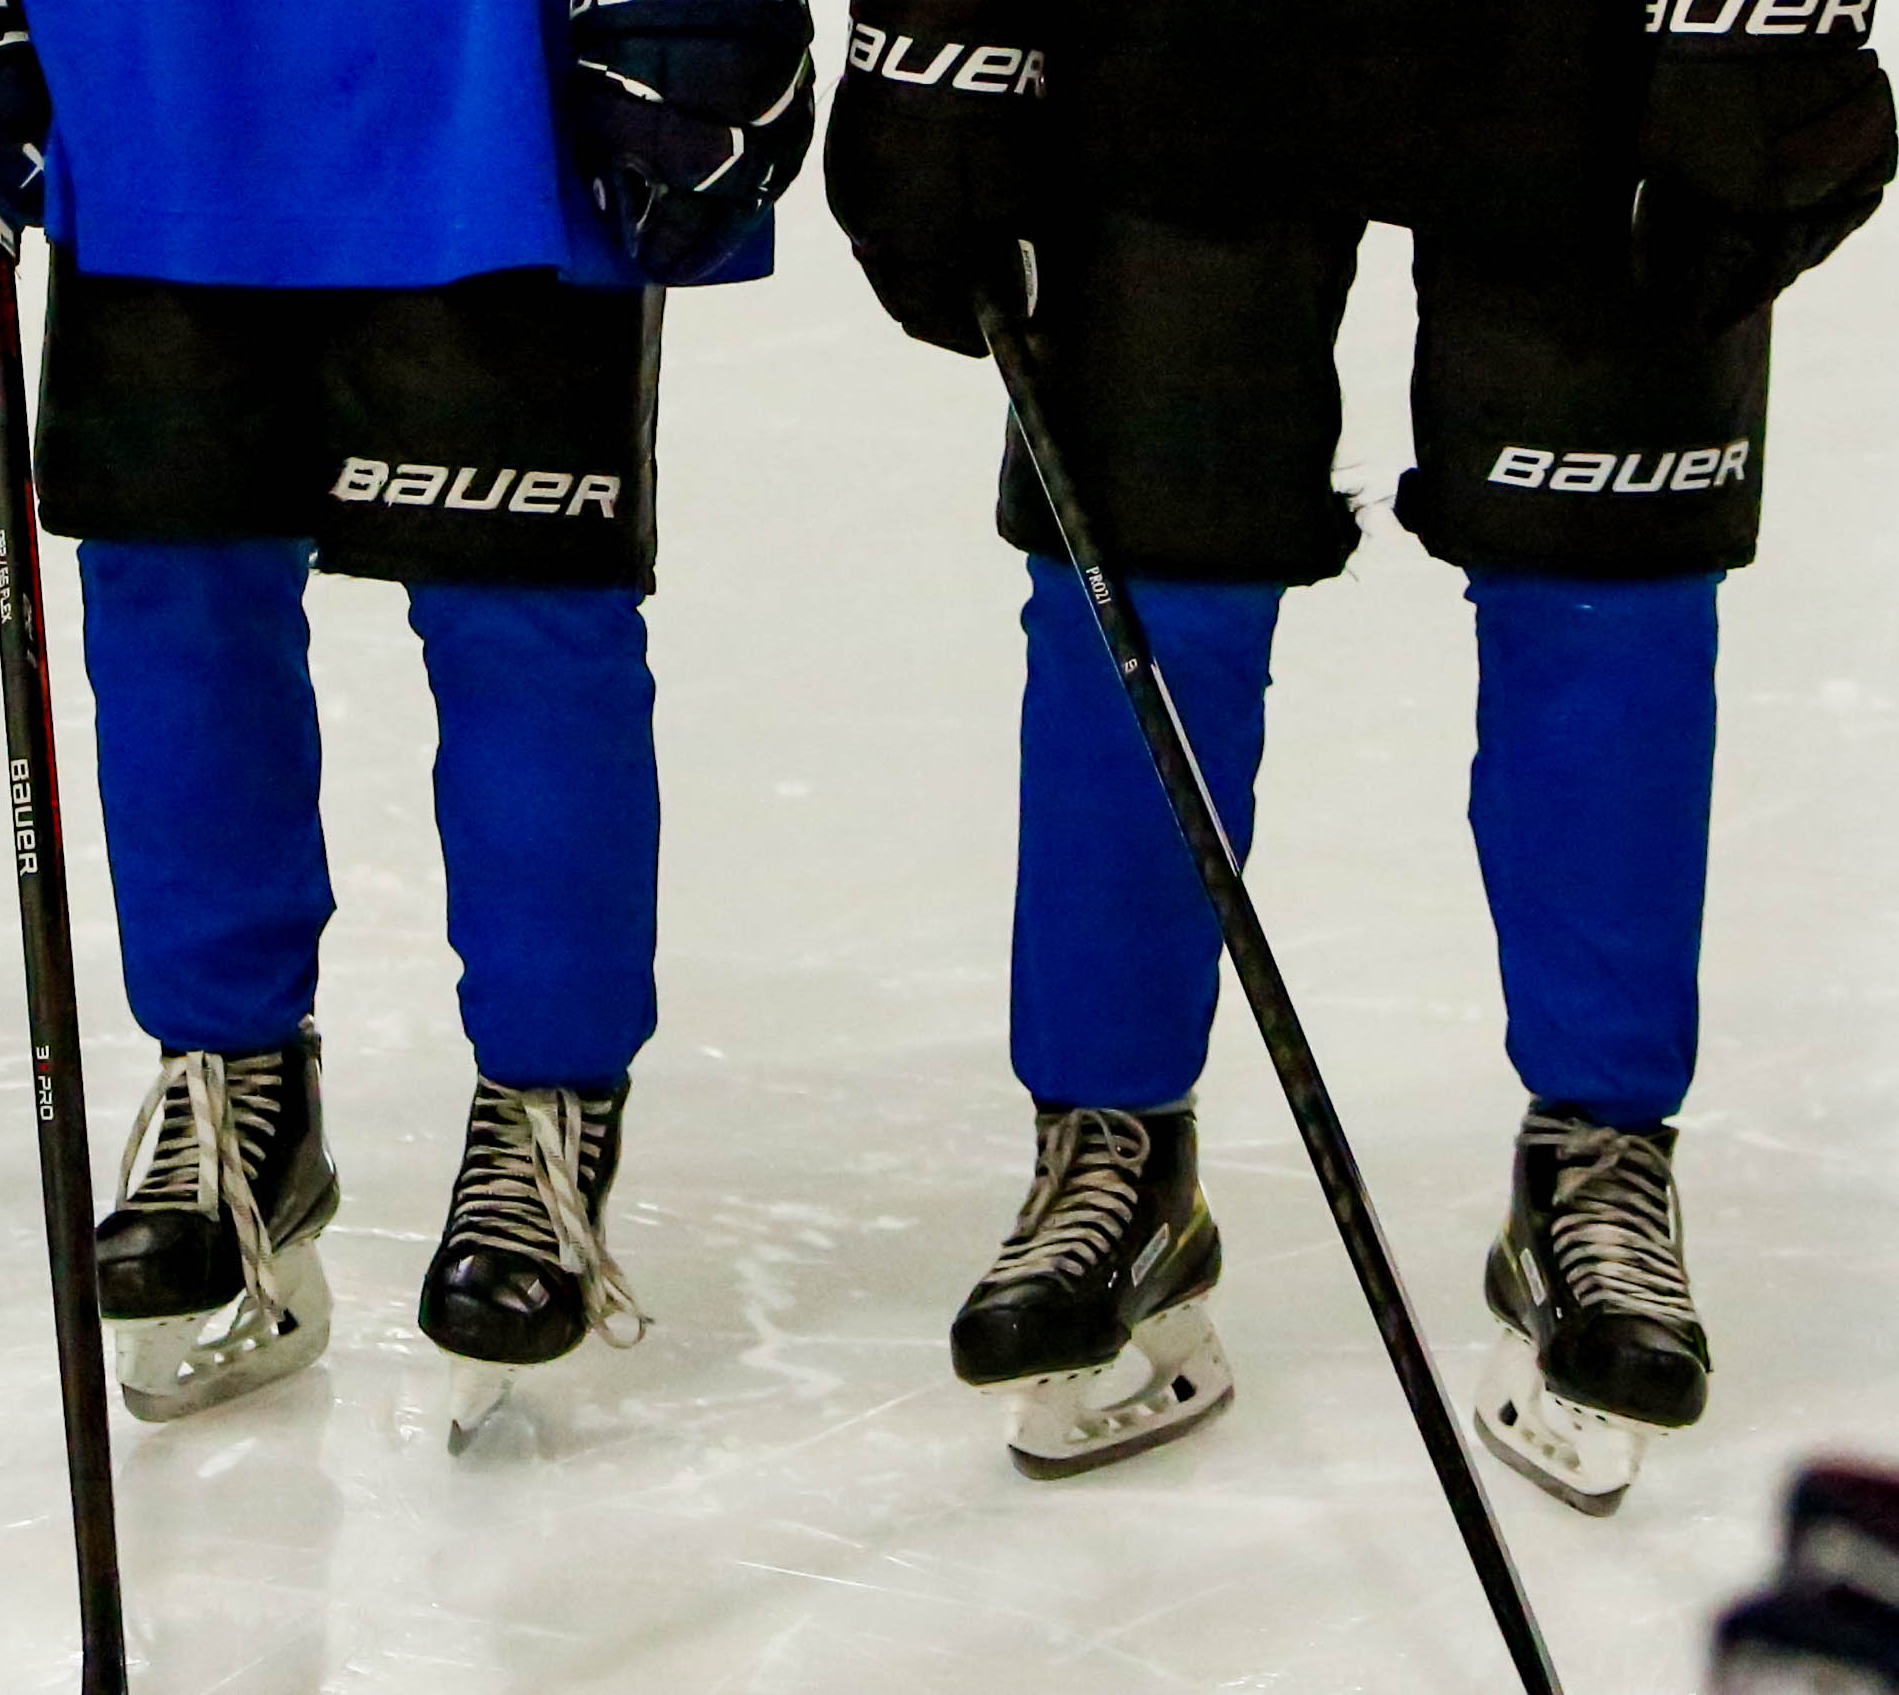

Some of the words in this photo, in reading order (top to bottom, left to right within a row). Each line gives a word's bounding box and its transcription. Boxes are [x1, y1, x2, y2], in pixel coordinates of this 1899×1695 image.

[847, 16, 1048, 99] AUER
[328, 457, 621, 519] BAUER
[1487, 439, 1749, 493] BAUER
[0, 588, 13, 625] FLEX
[10, 758, 39, 877] BAUER
[37, 1075, 55, 1121] PRO
